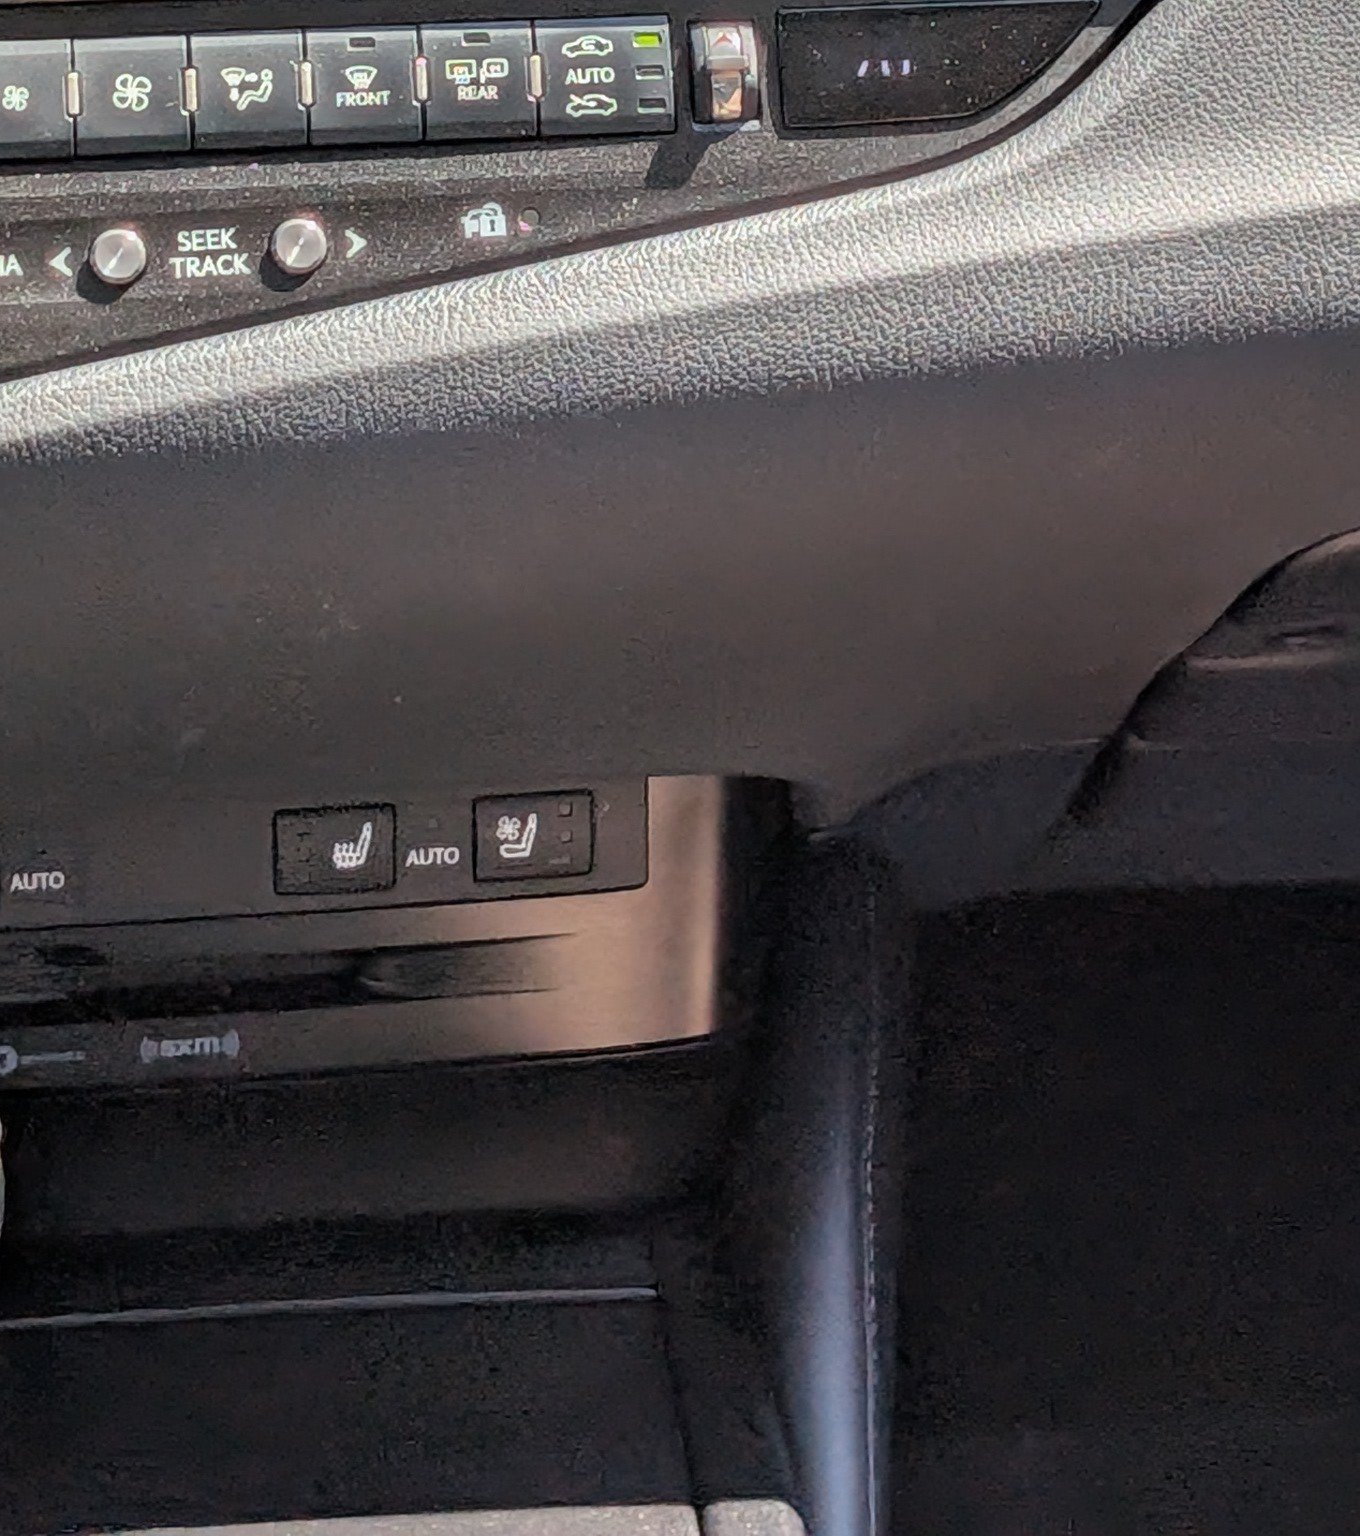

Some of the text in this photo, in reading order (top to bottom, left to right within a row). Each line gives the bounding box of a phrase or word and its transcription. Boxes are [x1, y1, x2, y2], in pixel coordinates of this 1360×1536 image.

[566, 67, 616, 86] AUTO
[336, 90, 391, 108] FRONT
[457, 85, 500, 102] REAR
[178, 227, 237, 253] SEEK
[169, 252, 252, 279] TRACK
[405, 846, 460, 868] AUTO
[9, 870, 66, 894] AUTO
